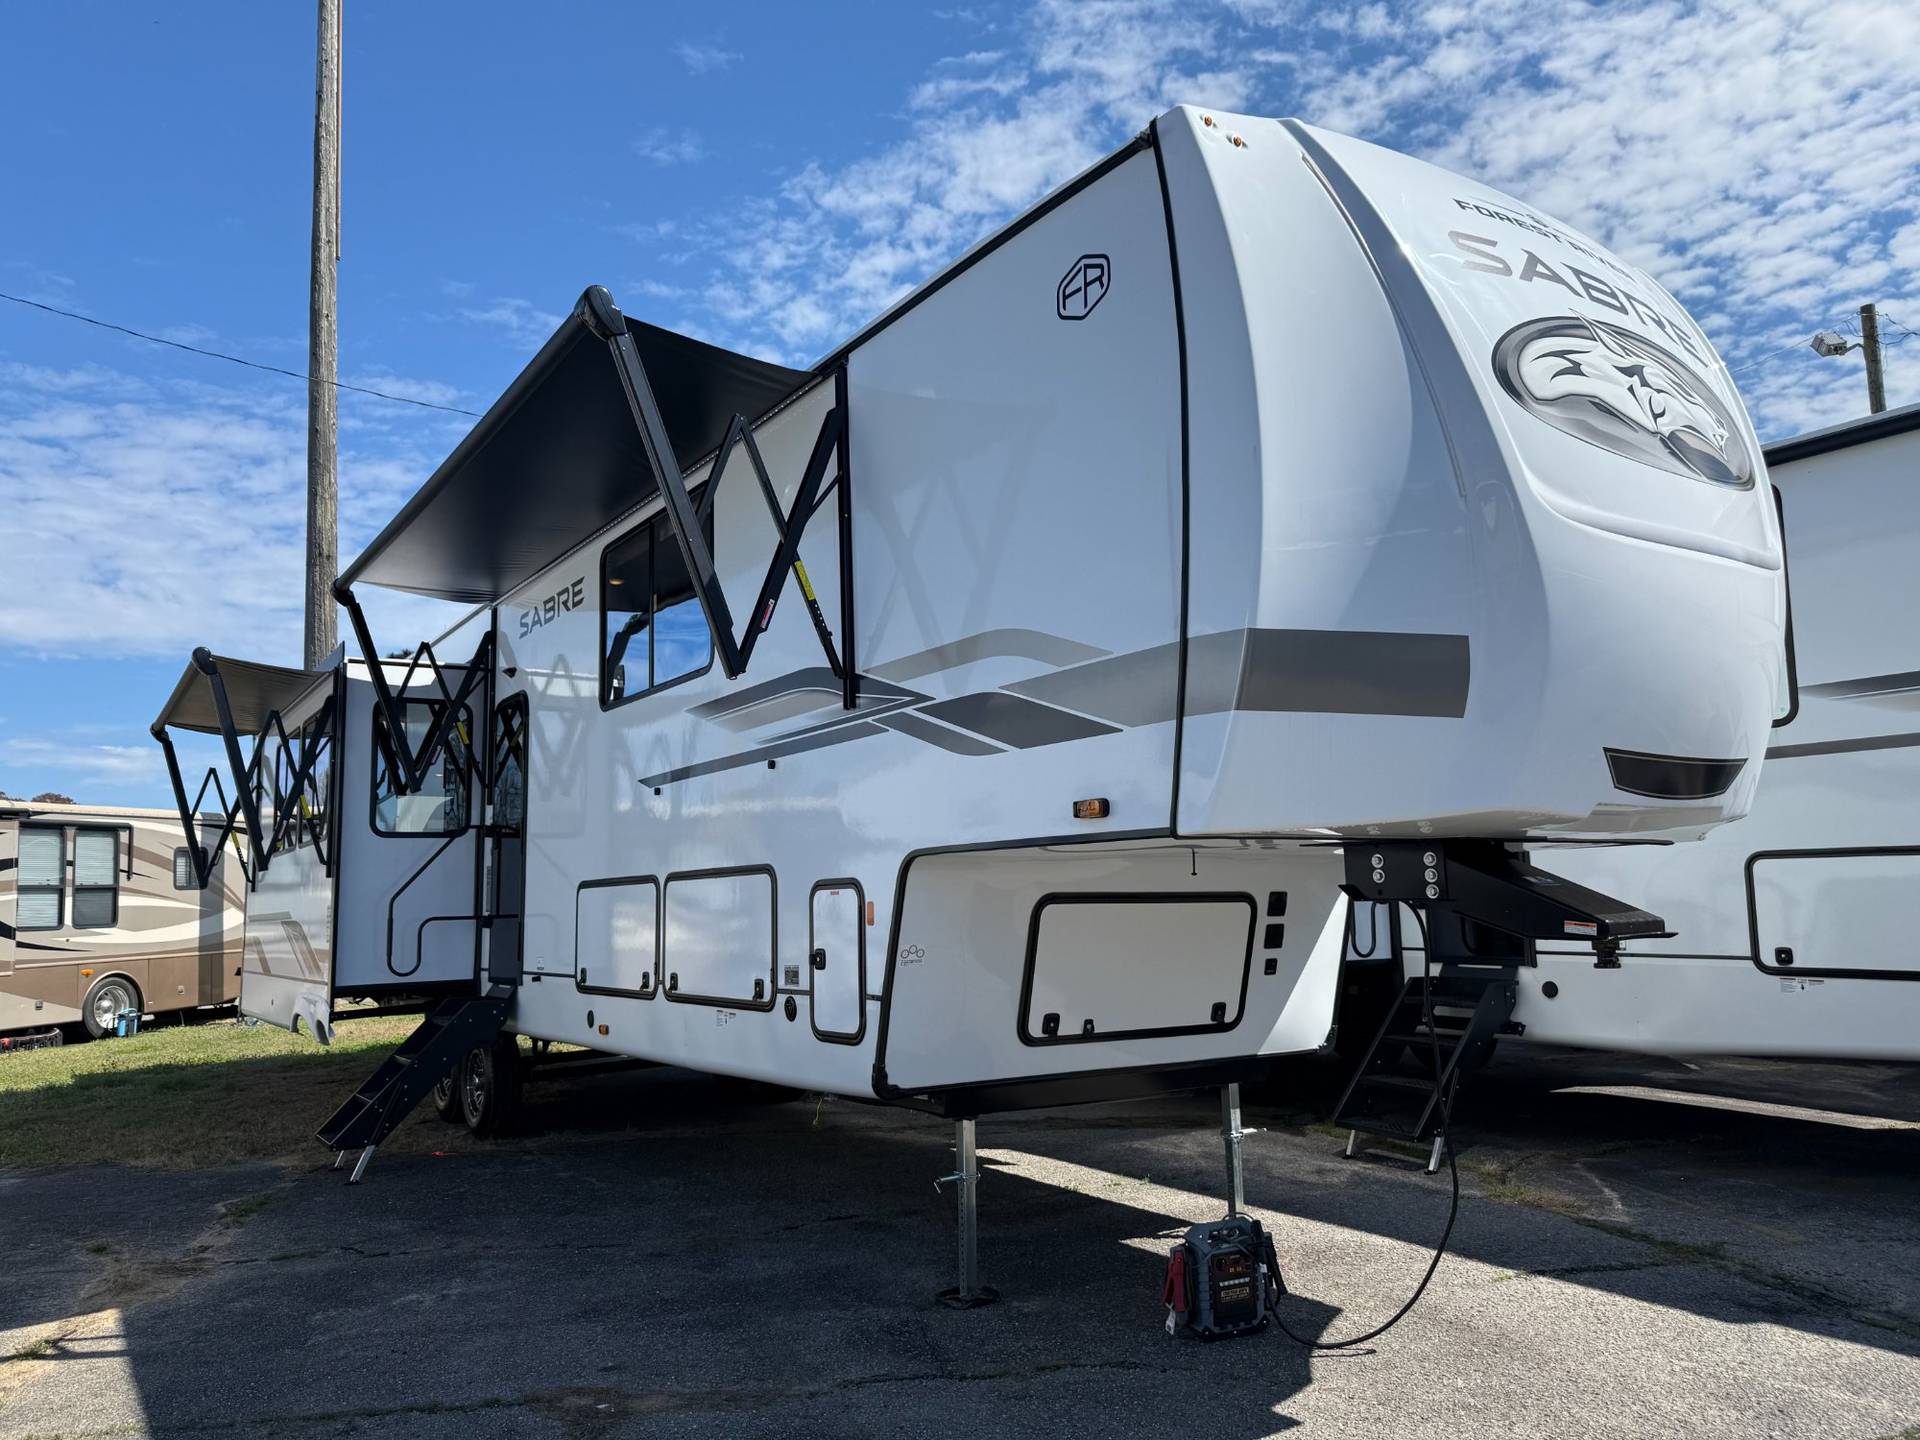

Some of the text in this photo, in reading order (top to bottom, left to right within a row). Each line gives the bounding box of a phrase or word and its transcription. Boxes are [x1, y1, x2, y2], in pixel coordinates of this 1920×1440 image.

[1452, 198, 1562, 243] FOREST
[1447, 230, 1709, 368] SABRE
[518, 575, 585, 640] SABRE
